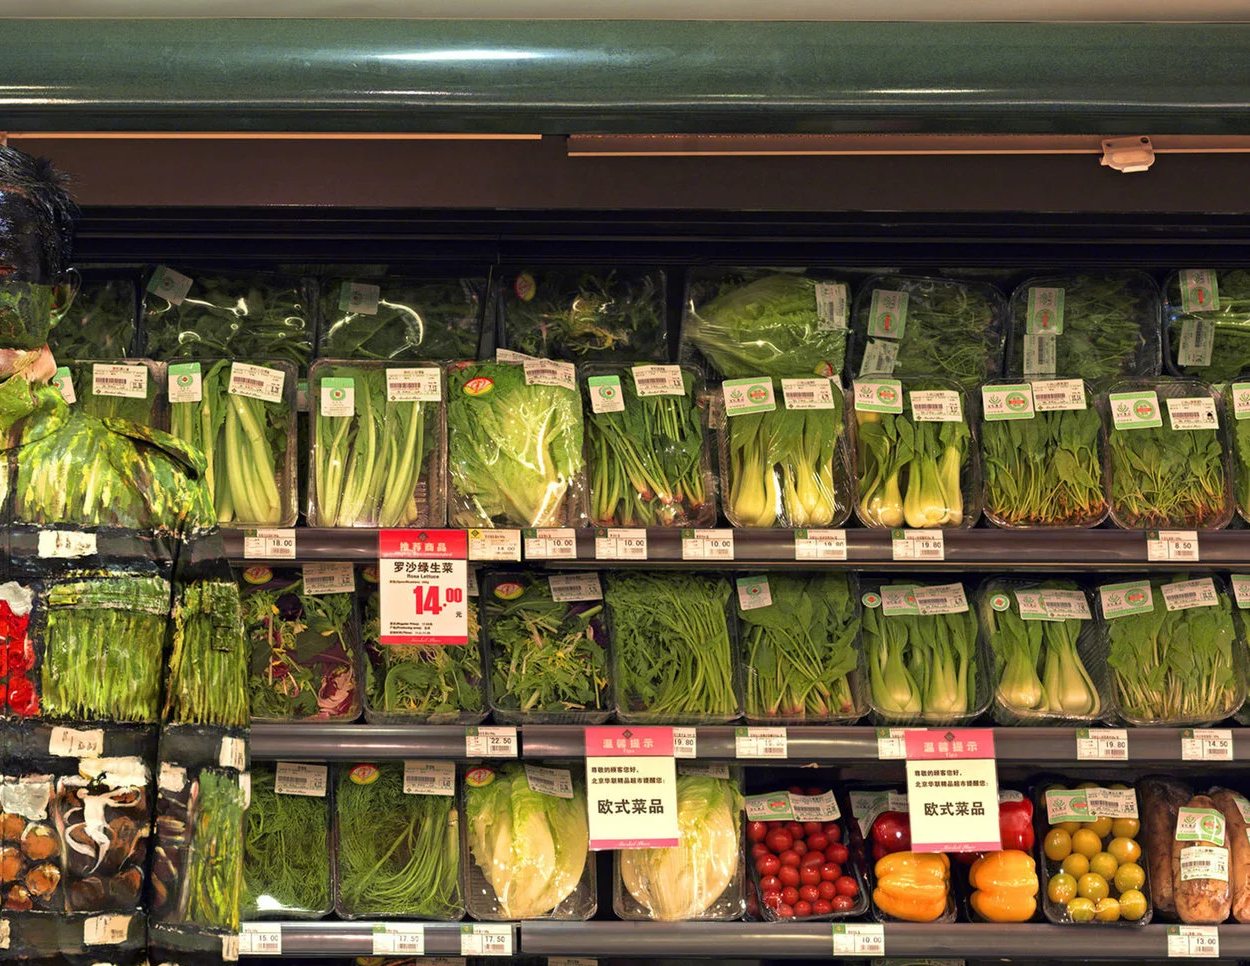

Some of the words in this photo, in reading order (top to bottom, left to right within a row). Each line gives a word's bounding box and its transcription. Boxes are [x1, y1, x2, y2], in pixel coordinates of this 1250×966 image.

[272, 539, 293, 547] 18.00
[399, 541, 447, 552] 推荐商品
[552, 539, 574, 547] 10.00
[624, 539, 645, 547] 10.00
[711, 540, 731, 548] 10.00
[921, 541, 942, 549] 19.80
[1175, 542, 1192, 550] 8.50
[393, 561, 454, 574] 罗沙绿生菜
[413, 585, 463, 615] 14.00
[490, 737, 512, 745] 22.50
[602, 738, 654, 749] 温馨提示
[1105, 740, 1127, 749] 19.80
[1208, 740, 1229, 748] 14.50
[923, 741, 978, 753] 温馨提示
[597, 798, 664, 815] 欧式菜品
[923, 801, 985, 817] 欧式菜品
[259, 935, 280, 943] 15.00
[485, 935, 506, 943] 17.50
[1196, 937, 1217, 945] 13.00
